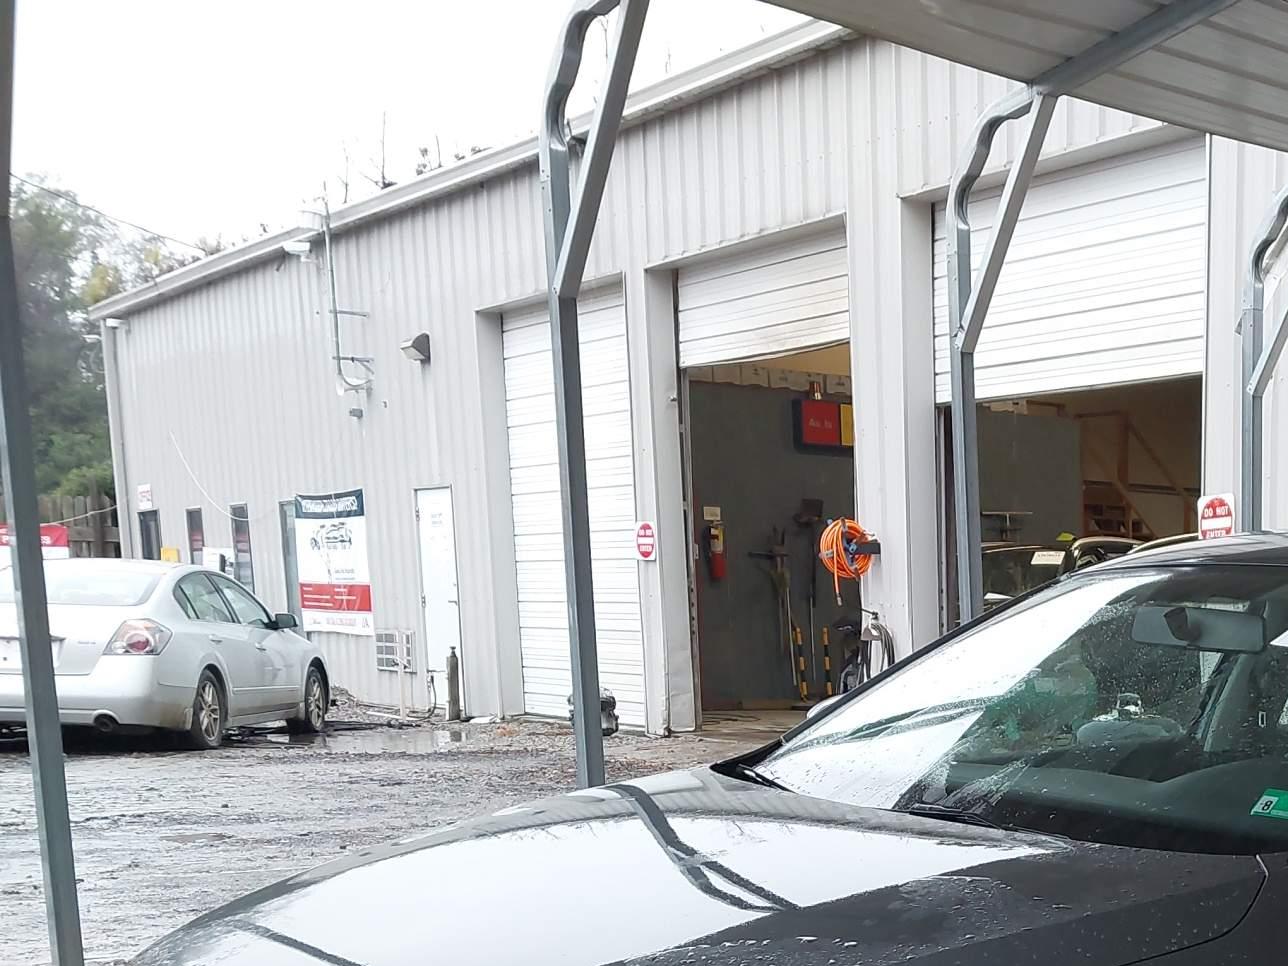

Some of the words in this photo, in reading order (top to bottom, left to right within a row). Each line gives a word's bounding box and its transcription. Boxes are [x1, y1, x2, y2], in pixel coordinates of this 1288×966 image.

[1204, 507, 1213, 517] DO
[1216, 505, 1228, 516] NOT
[1262, 800, 1273, 811] 8
